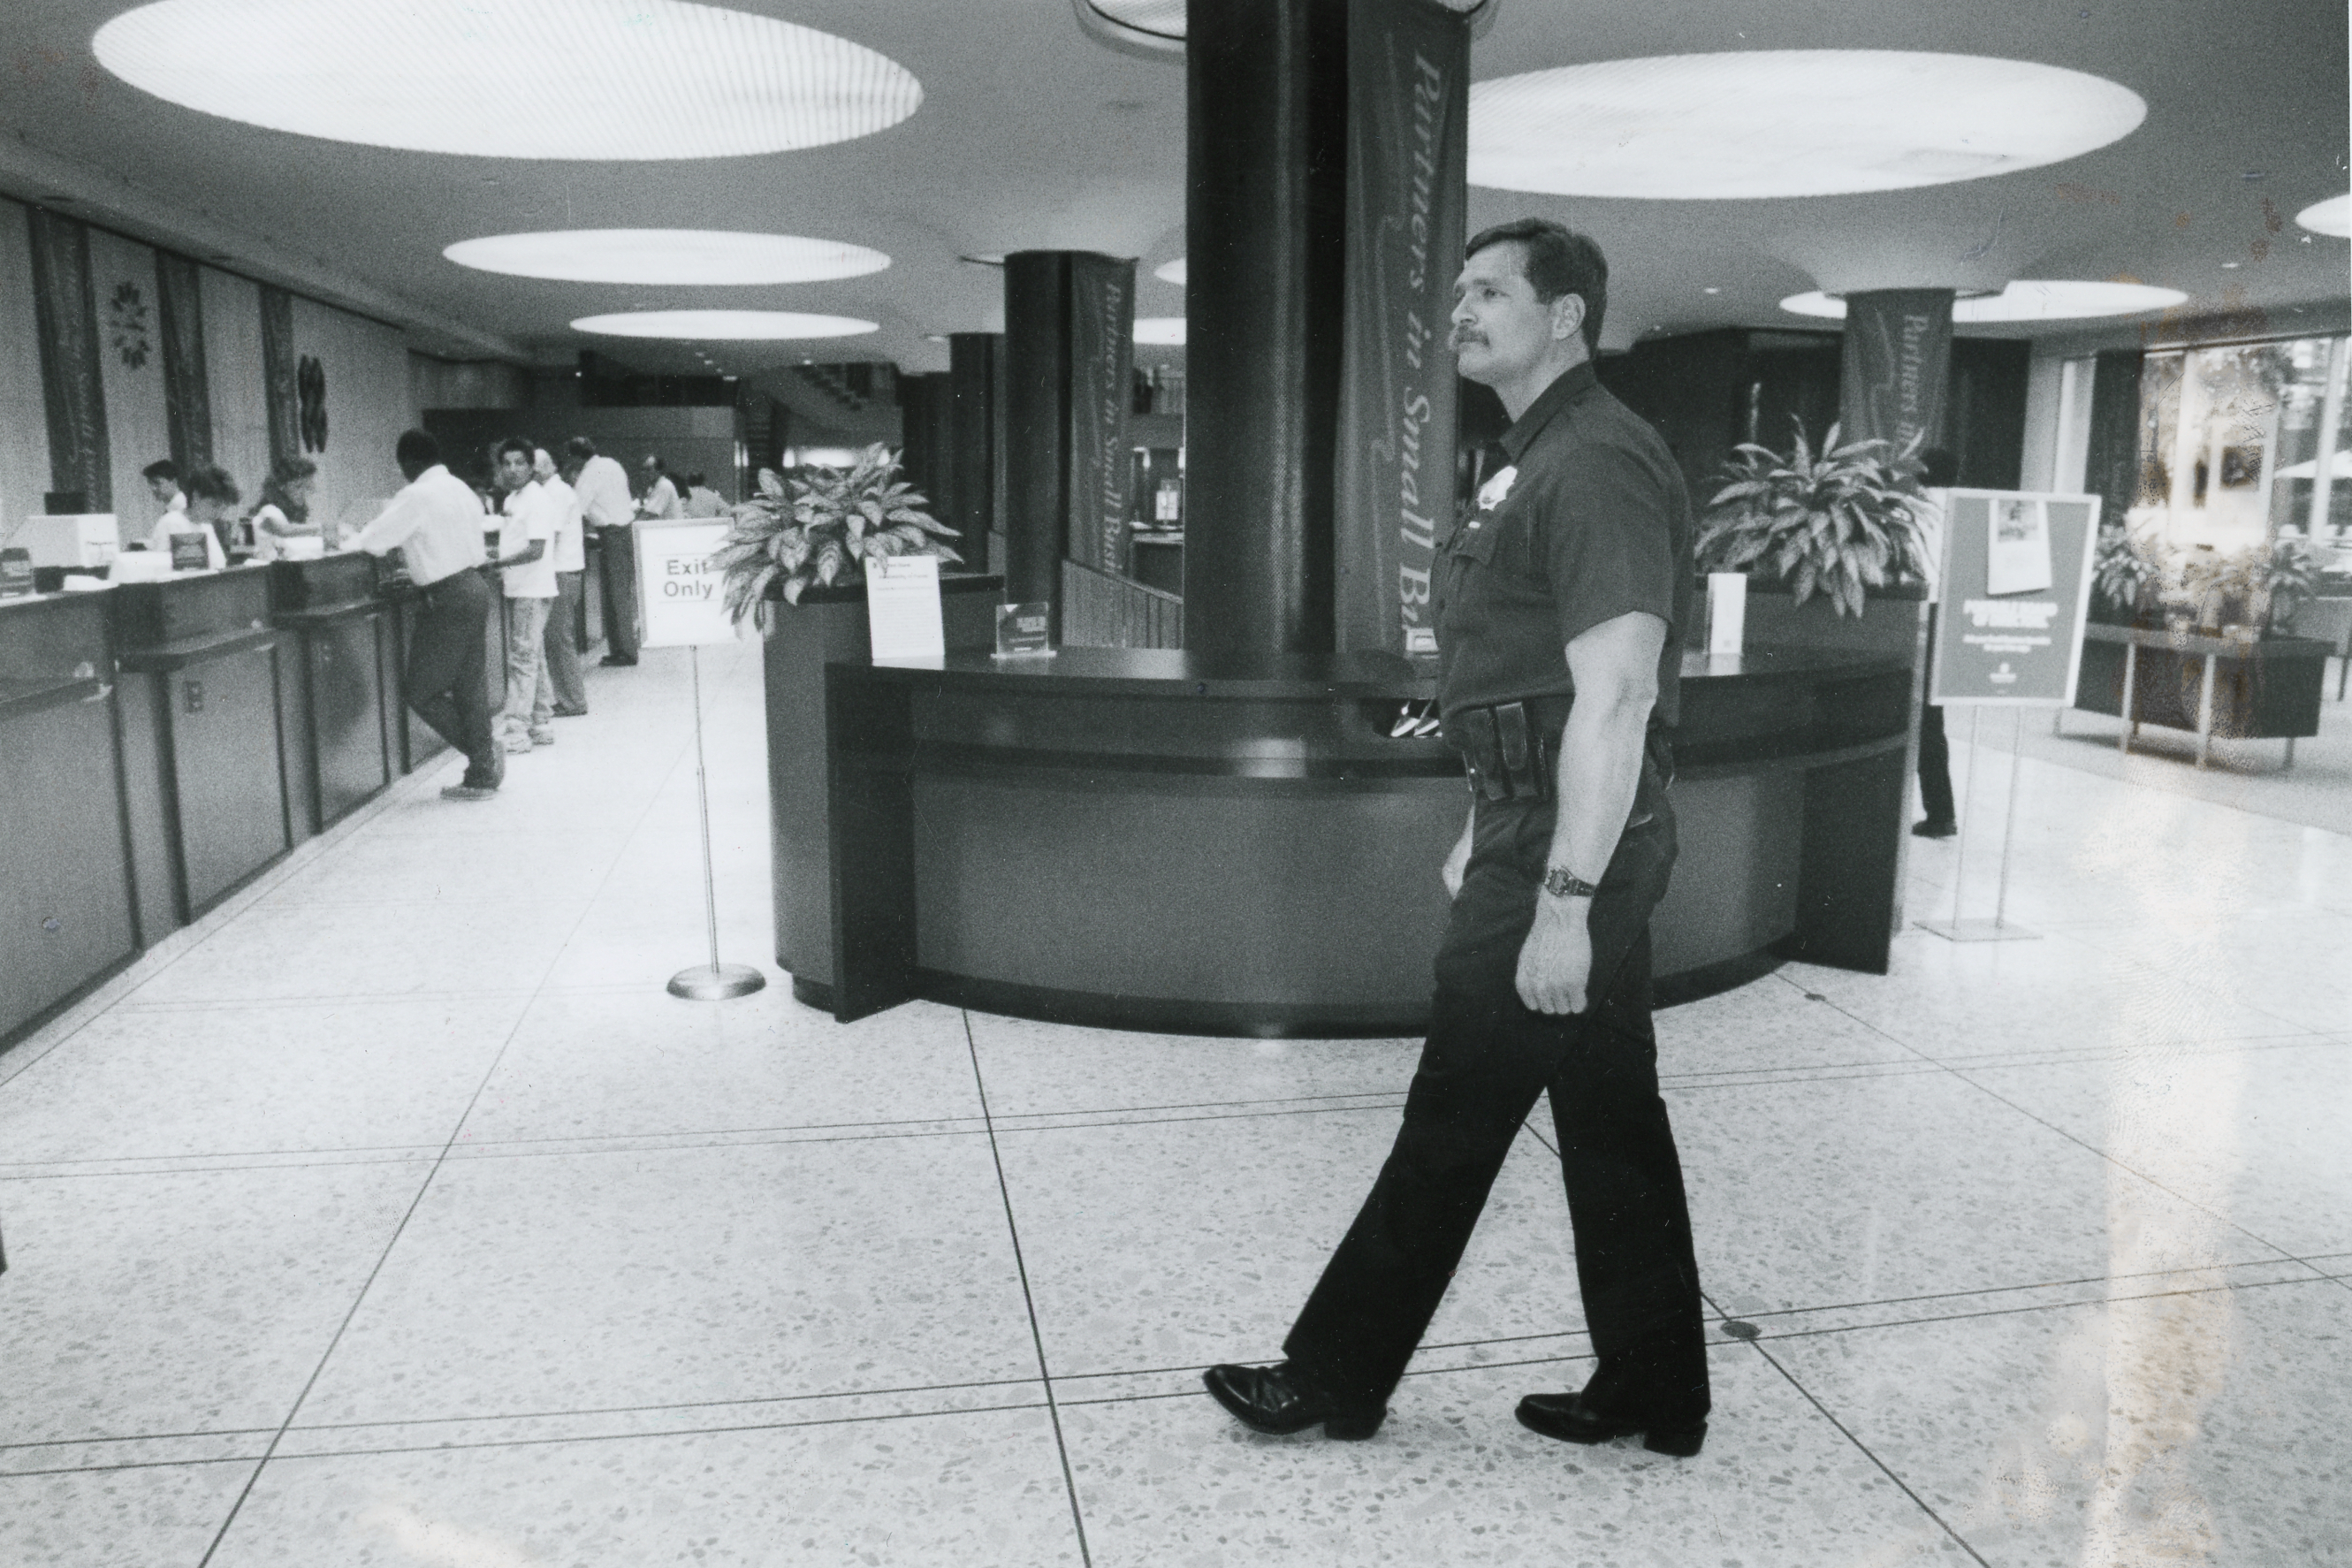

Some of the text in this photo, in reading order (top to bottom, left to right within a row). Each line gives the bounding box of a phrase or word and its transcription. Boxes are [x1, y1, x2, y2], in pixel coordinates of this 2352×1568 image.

[1409, 51, 1442, 293] Partners
[1105, 282, 1122, 389] Partners
[1406, 311, 1431, 369] in
[1901, 315, 1930, 413] Partners
[1105, 399, 1120, 424] in
[1105, 436, 1123, 508] Small
[1401, 385, 1435, 549] Small
[664, 580, 713, 599] Only
[666, 559, 709, 575] Exit
